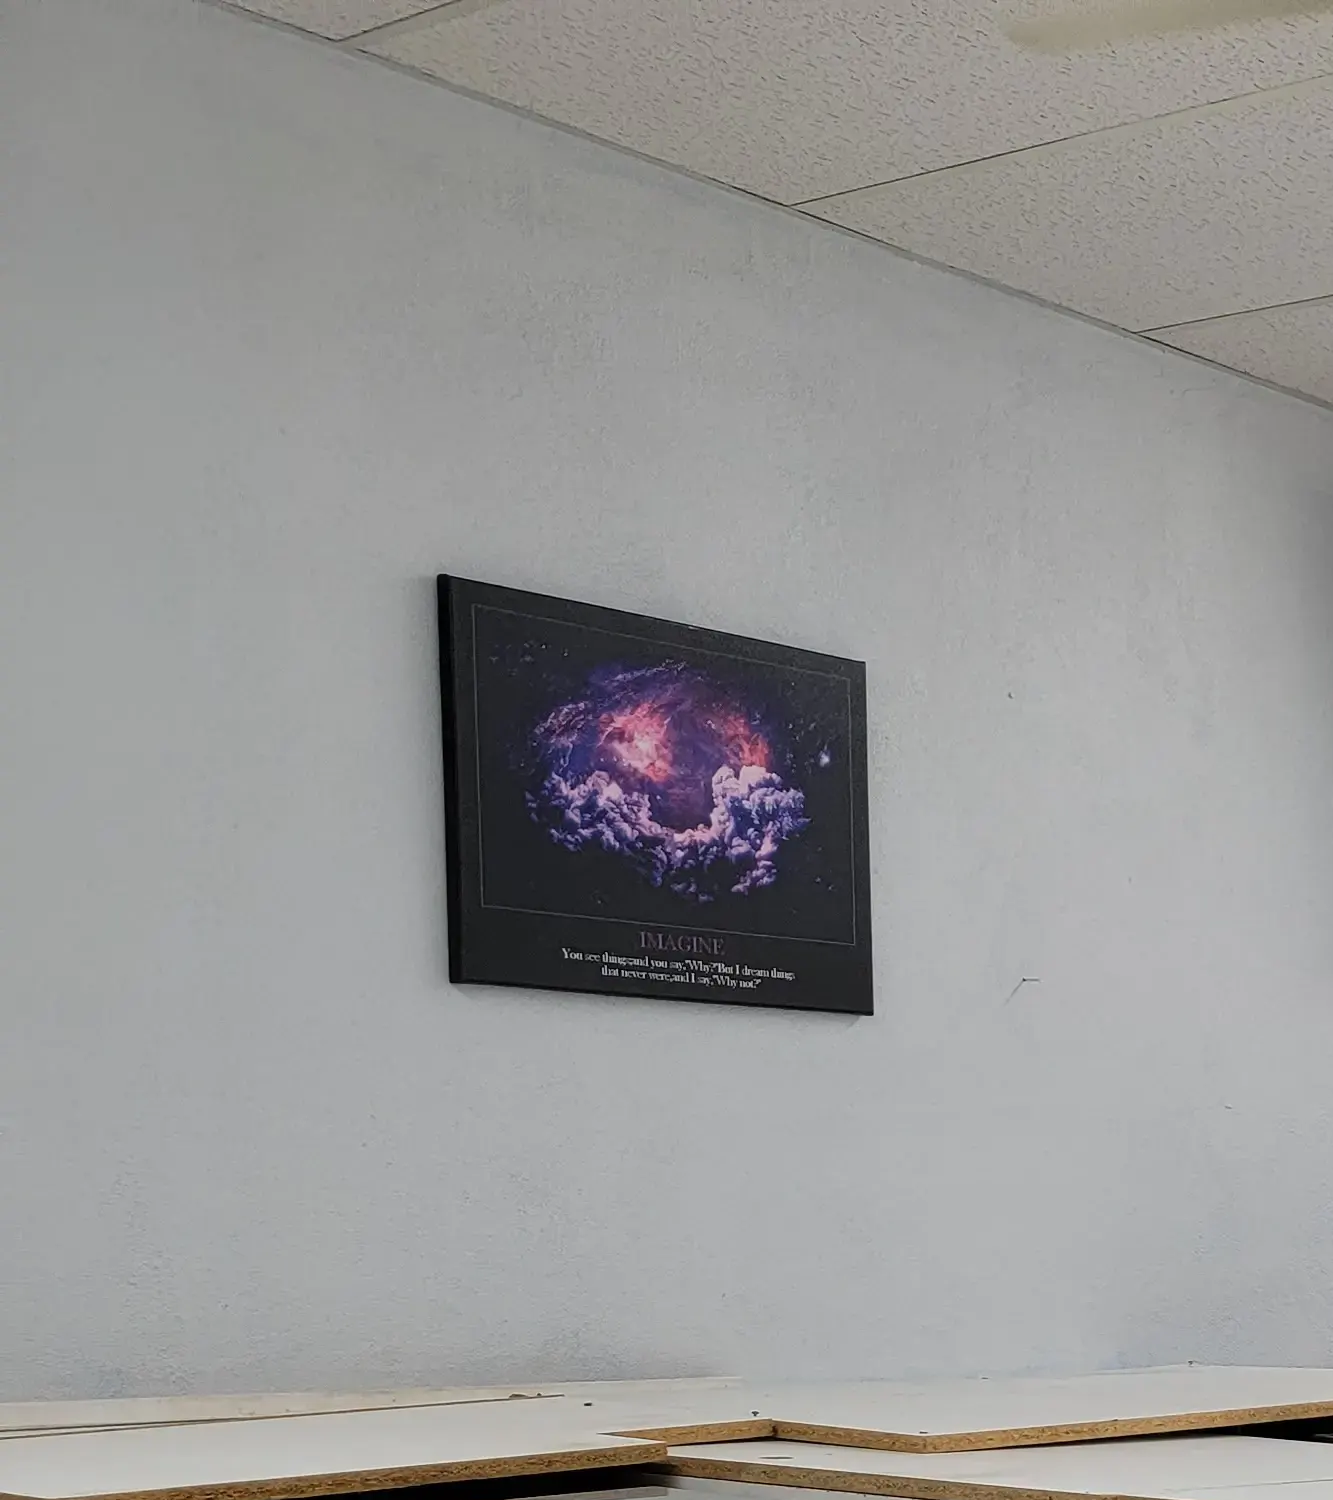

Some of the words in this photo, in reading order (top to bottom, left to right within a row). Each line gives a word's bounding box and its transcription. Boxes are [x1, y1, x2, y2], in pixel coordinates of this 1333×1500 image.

[639, 931, 725, 955] IMAGINE
[561, 948, 583, 960] You
[651, 959, 667, 969] you
[736, 965, 740, 975] I
[742, 965, 769, 977] dream
[602, 965, 619, 976] that
[621, 969, 647, 979] never
[691, 973, 695, 983] I
